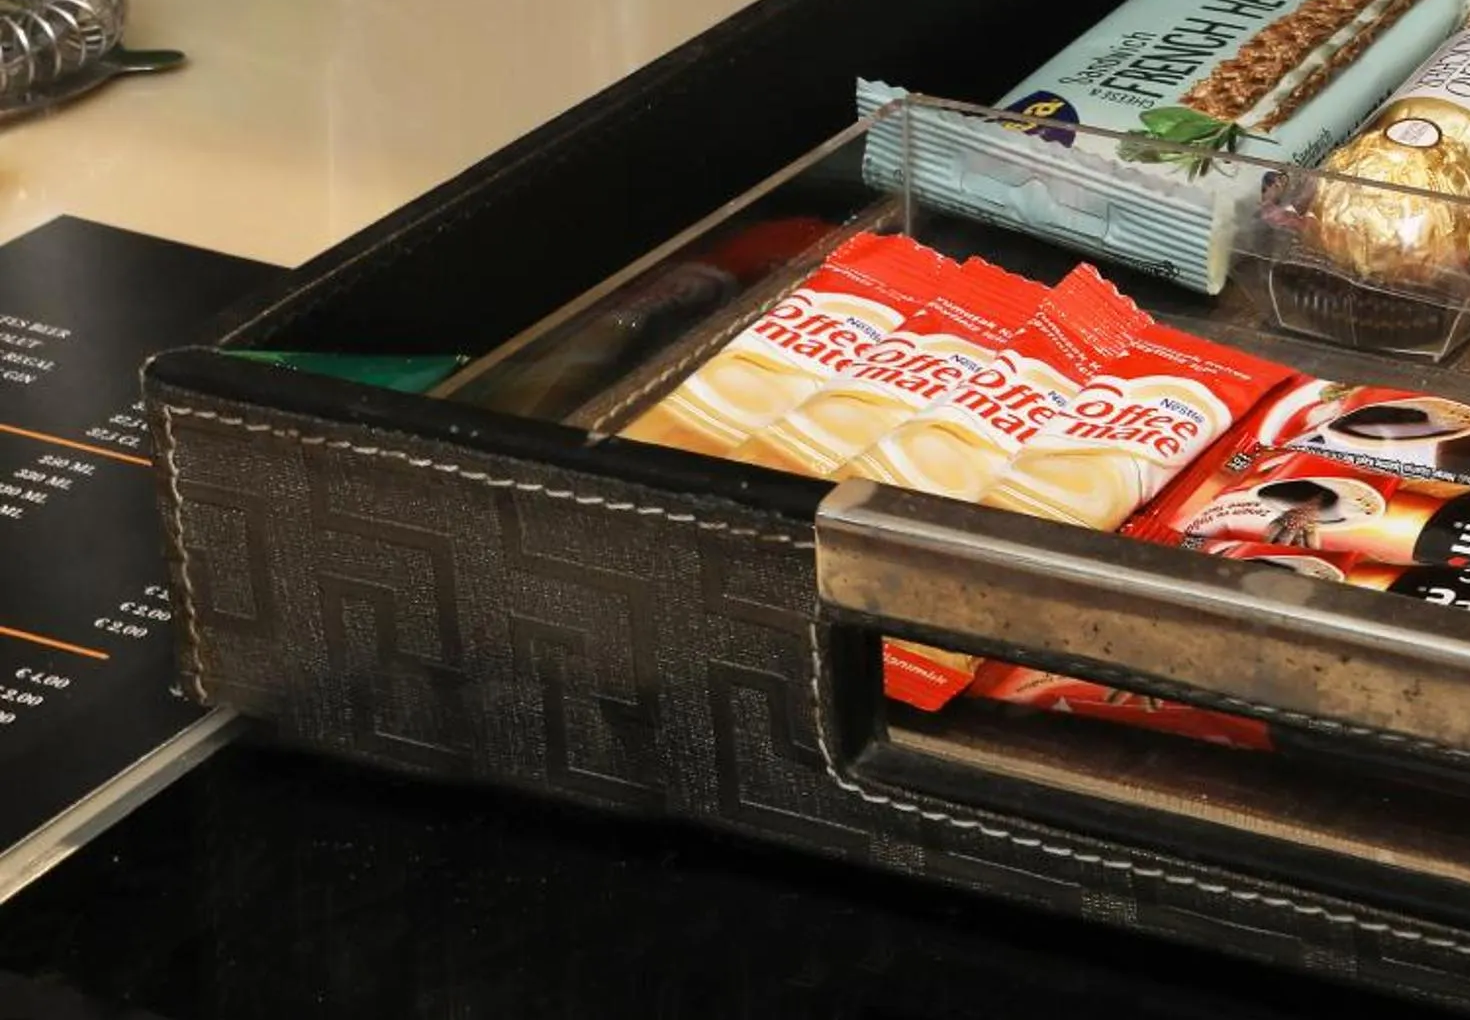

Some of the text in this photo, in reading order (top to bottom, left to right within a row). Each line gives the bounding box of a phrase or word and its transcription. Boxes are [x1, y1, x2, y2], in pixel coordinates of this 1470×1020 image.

[1058, 29, 1159, 88] Sandwich
[1099, 15, 1248, 99] FRENCH
[851, 363, 948, 400] mat
[952, 387, 1042, 445] mat
